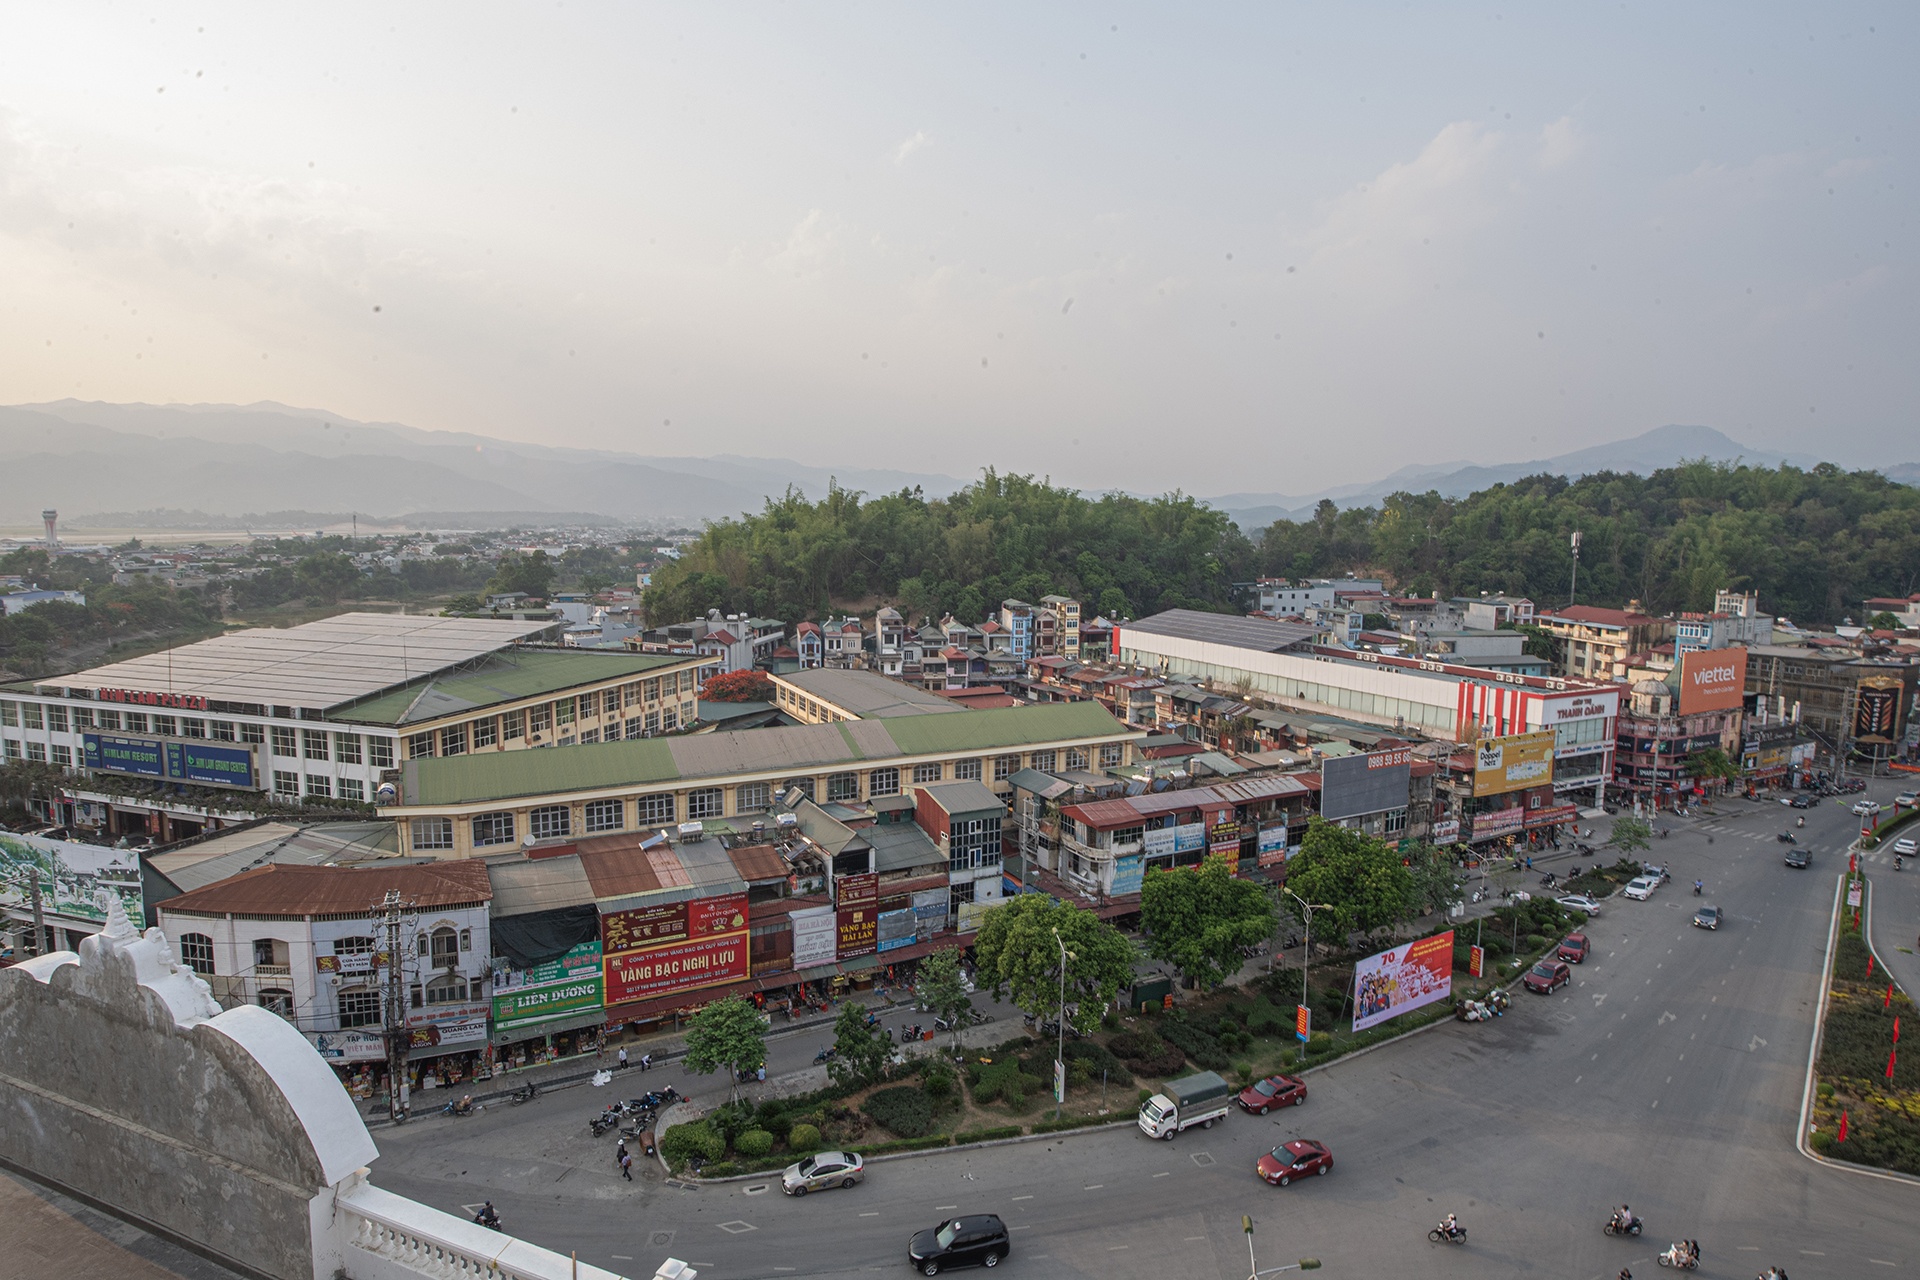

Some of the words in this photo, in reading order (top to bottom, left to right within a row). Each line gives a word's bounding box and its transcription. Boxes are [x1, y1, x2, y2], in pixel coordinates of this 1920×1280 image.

[1693, 665, 1736, 685] viettel
[129, 690, 157, 705] LAM
[161, 692, 208, 710] PLAZA
[1557, 707, 1583, 719] THANH
[103, 748, 131, 760] HIMLAM
[132, 752, 158, 763] RESORT
[230, 761, 248, 774] CENTER
[840, 922, 860, 933] VÀNG
[862, 921, 876, 931] BẠC
[1382, 952, 1395, 966] 70
[620, 966, 652, 983] VÀNG
[656, 961, 679, 978] BẠC
[682, 954, 709, 972] NGHỊ
[712, 950, 735, 967] LỰU
[518, 992, 548, 1008] LIÊN
[552, 984, 596, 1001] DƯƠNG
[346, 1036, 361, 1044] TẠP
[347, 1044, 364, 1052] VIỆT
